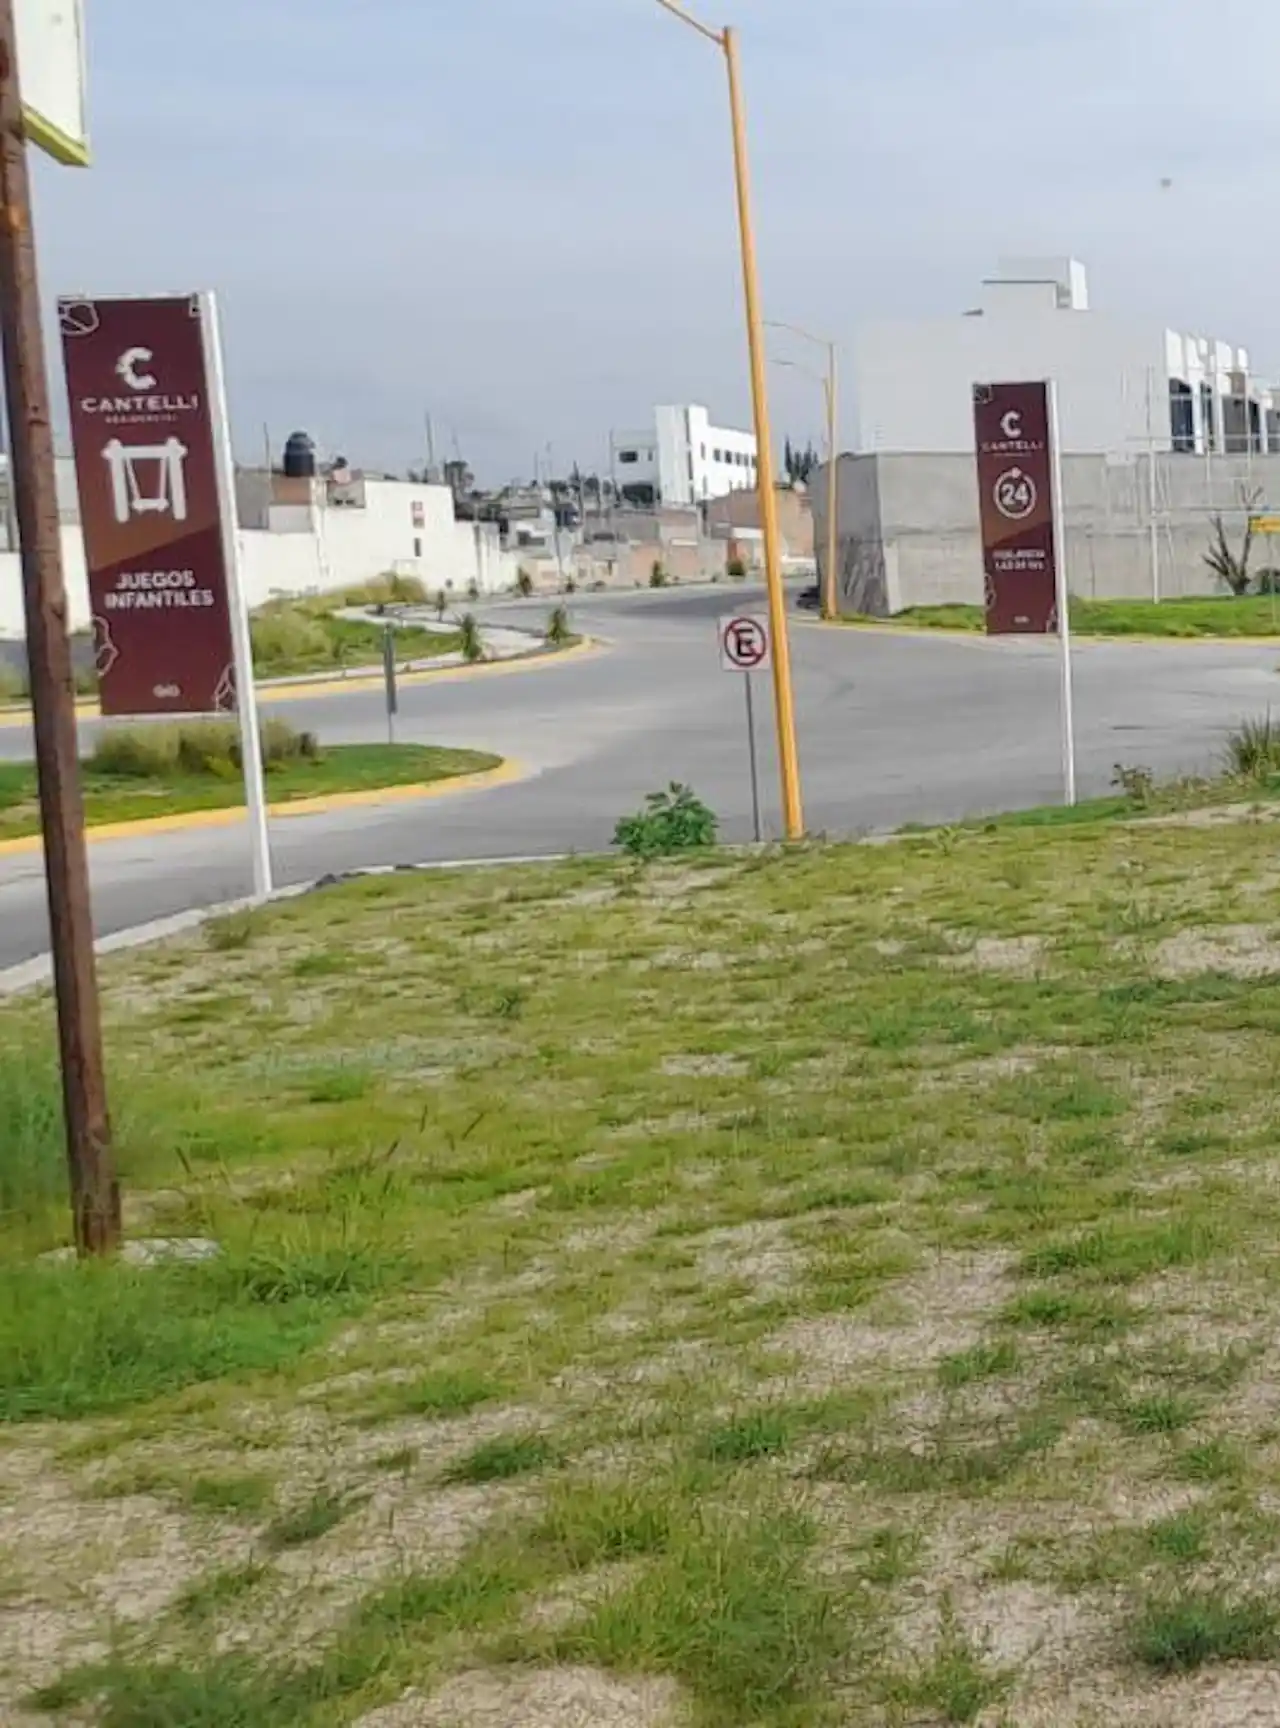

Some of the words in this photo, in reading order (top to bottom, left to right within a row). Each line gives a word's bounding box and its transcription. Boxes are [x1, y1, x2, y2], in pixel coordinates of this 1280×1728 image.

[115, 346, 157, 390] C
[80, 394, 199, 414] CANTELLI
[1000, 410, 1022, 439] C
[1000, 483, 1029, 506] 24
[115, 570, 196, 590] JUEGOS
[104, 588, 215, 609] INFANTILES
[736, 628, 755, 657] E
